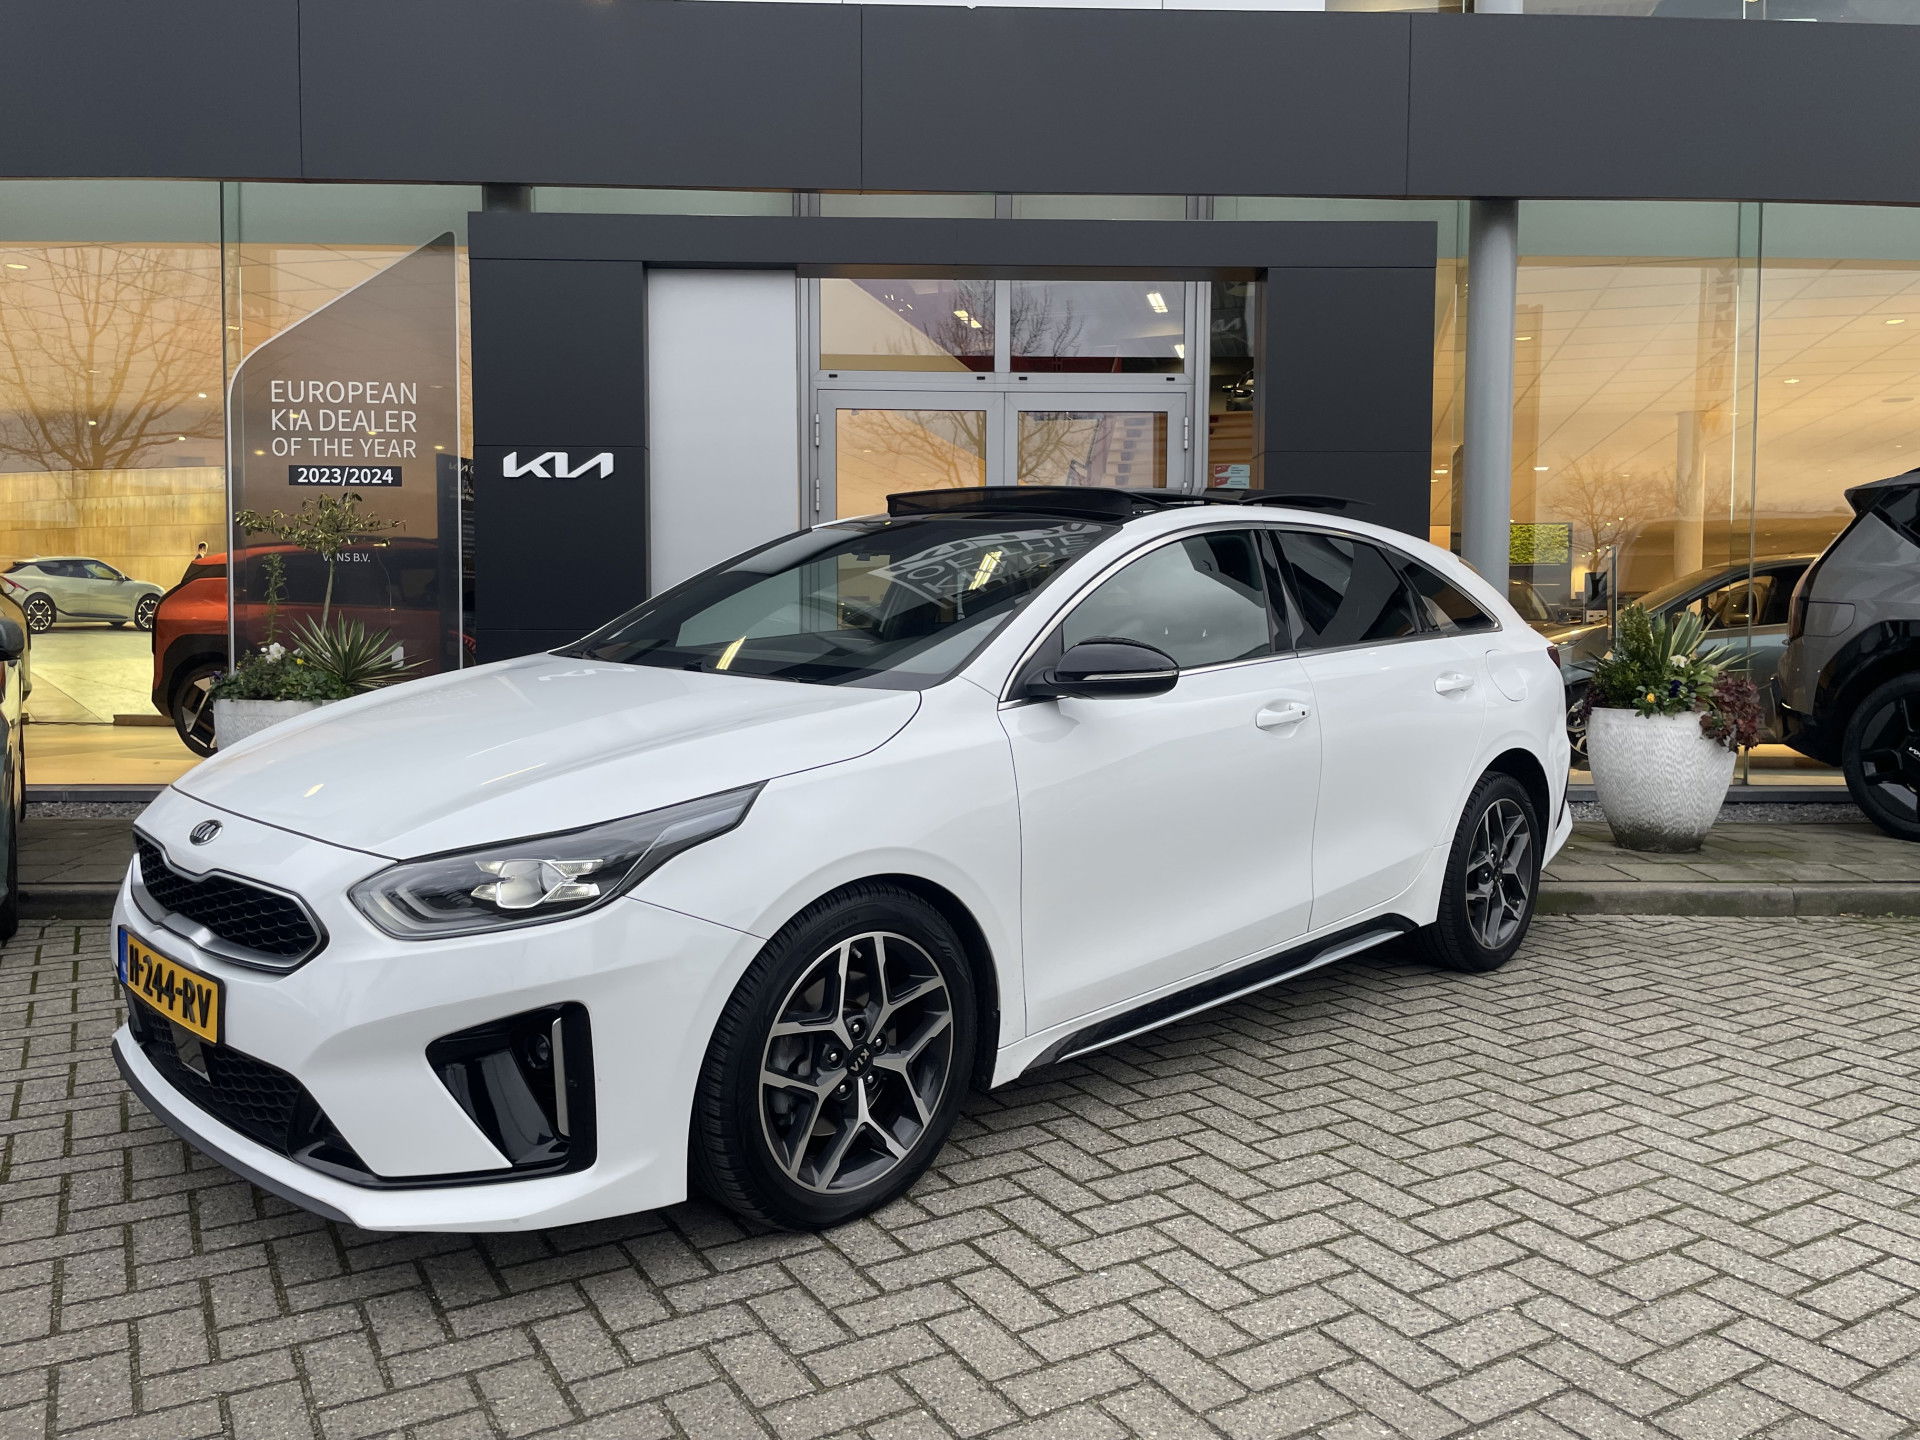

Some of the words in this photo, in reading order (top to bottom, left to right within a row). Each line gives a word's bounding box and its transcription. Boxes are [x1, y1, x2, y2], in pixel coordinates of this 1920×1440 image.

[270, 380, 417, 404] EUROPEAN
[271, 408, 312, 431] KIA
[319, 409, 417, 433] DEALER
[272, 437, 302, 457] OF
[308, 437, 354, 458] THE
[359, 438, 417, 459] YEAR
[503, 451, 614, 479] KIA
[297, 467, 394, 487] 2023/2024
[353, 552, 371, 563] B.V.
[129, 944, 212, 1029] H-244-RV
[850, 1048, 870, 1071] KIA
